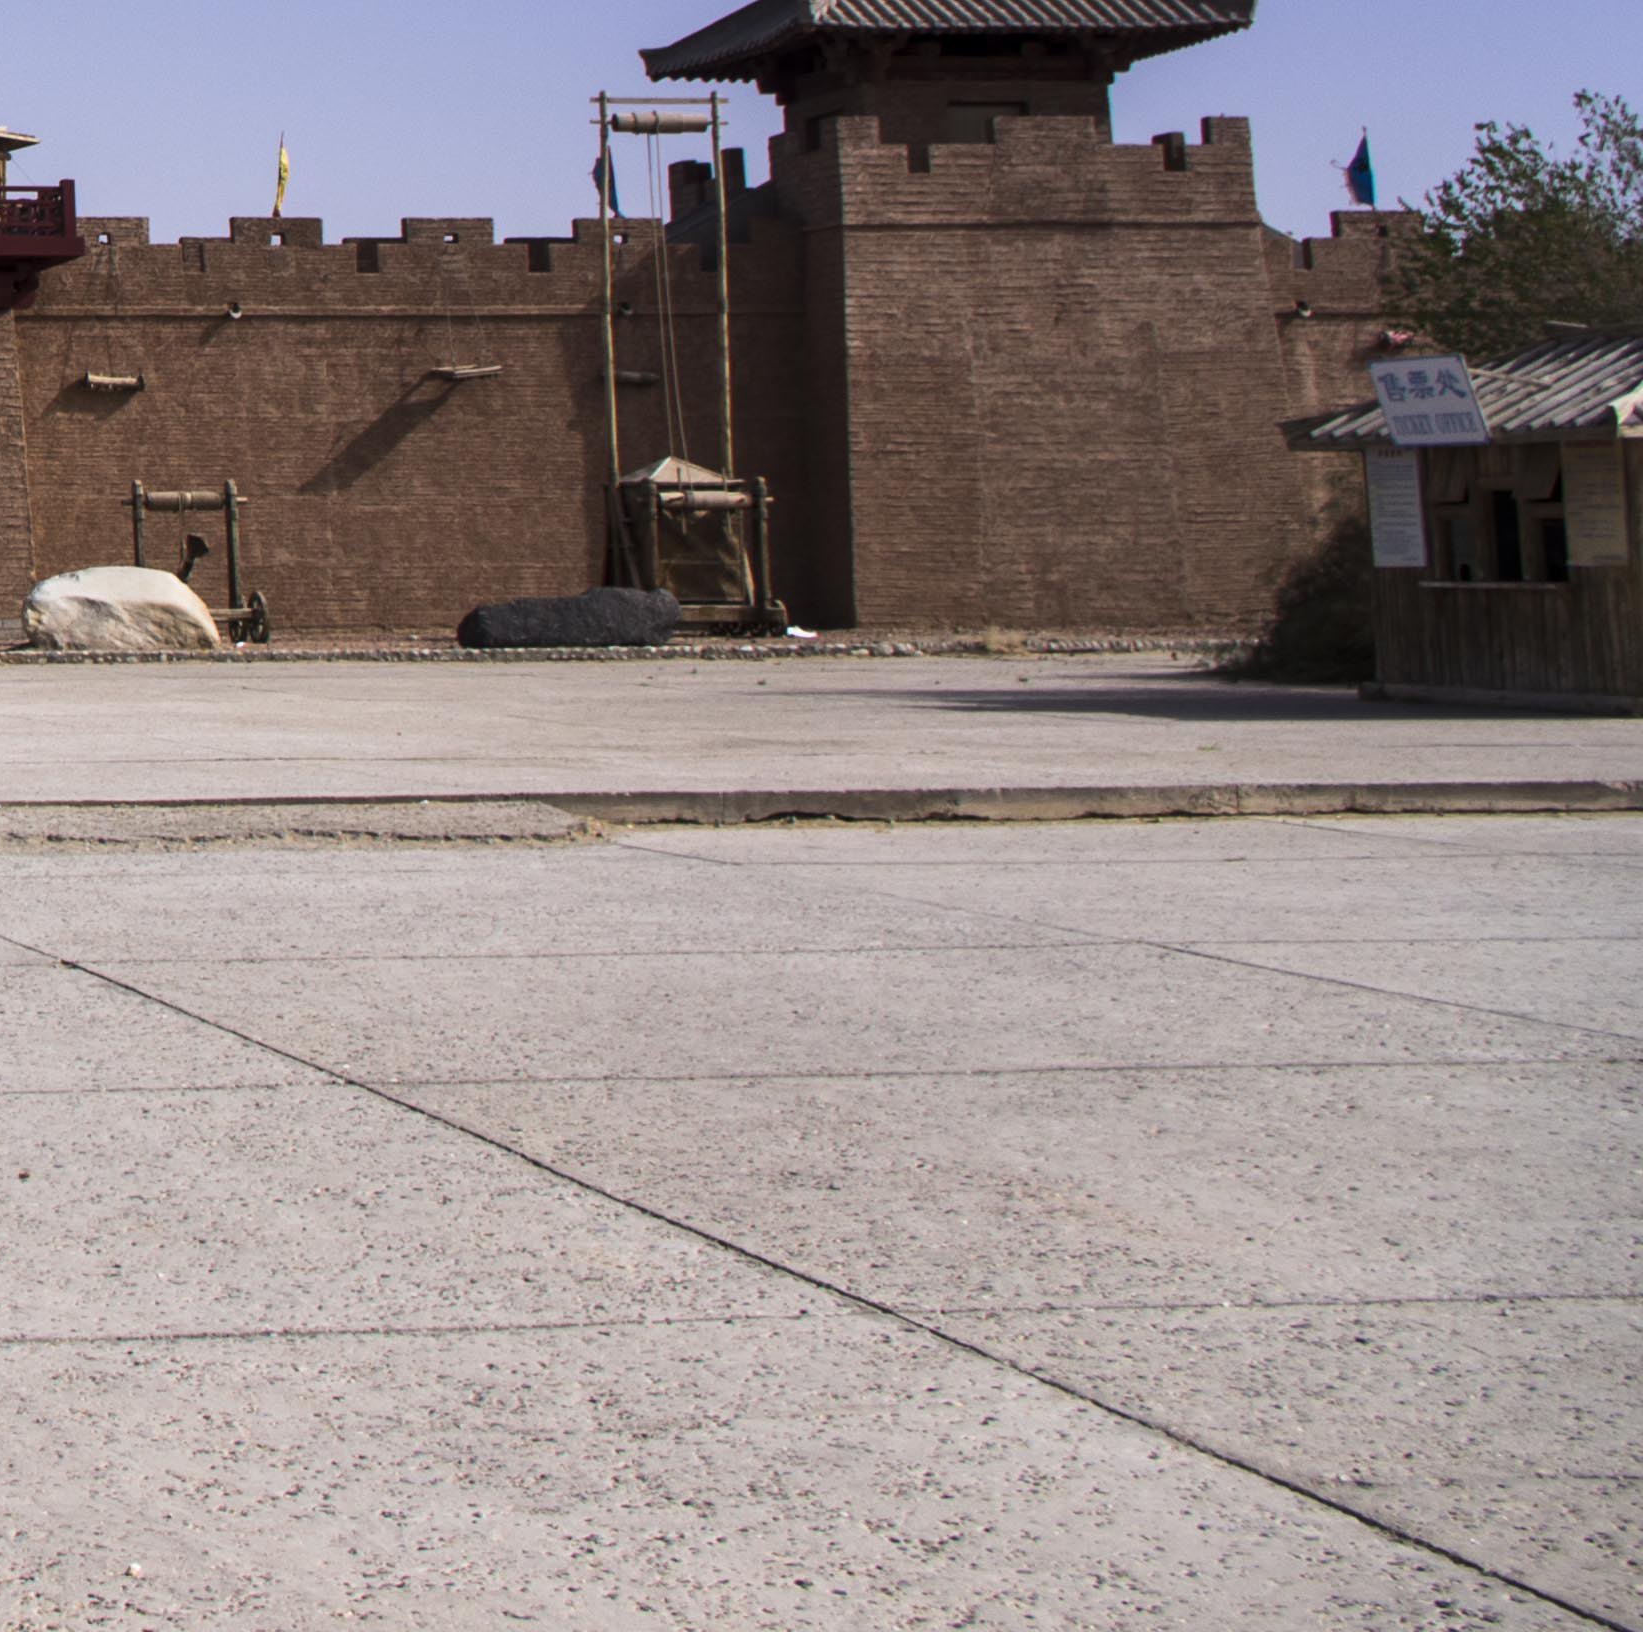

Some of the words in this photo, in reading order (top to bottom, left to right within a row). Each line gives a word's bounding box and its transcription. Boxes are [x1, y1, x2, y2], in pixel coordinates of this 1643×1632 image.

[1379, 369, 1466, 402] 售票处
[1393, 415, 1434, 435] TICKET
[1435, 412, 1478, 433] OFFICE
